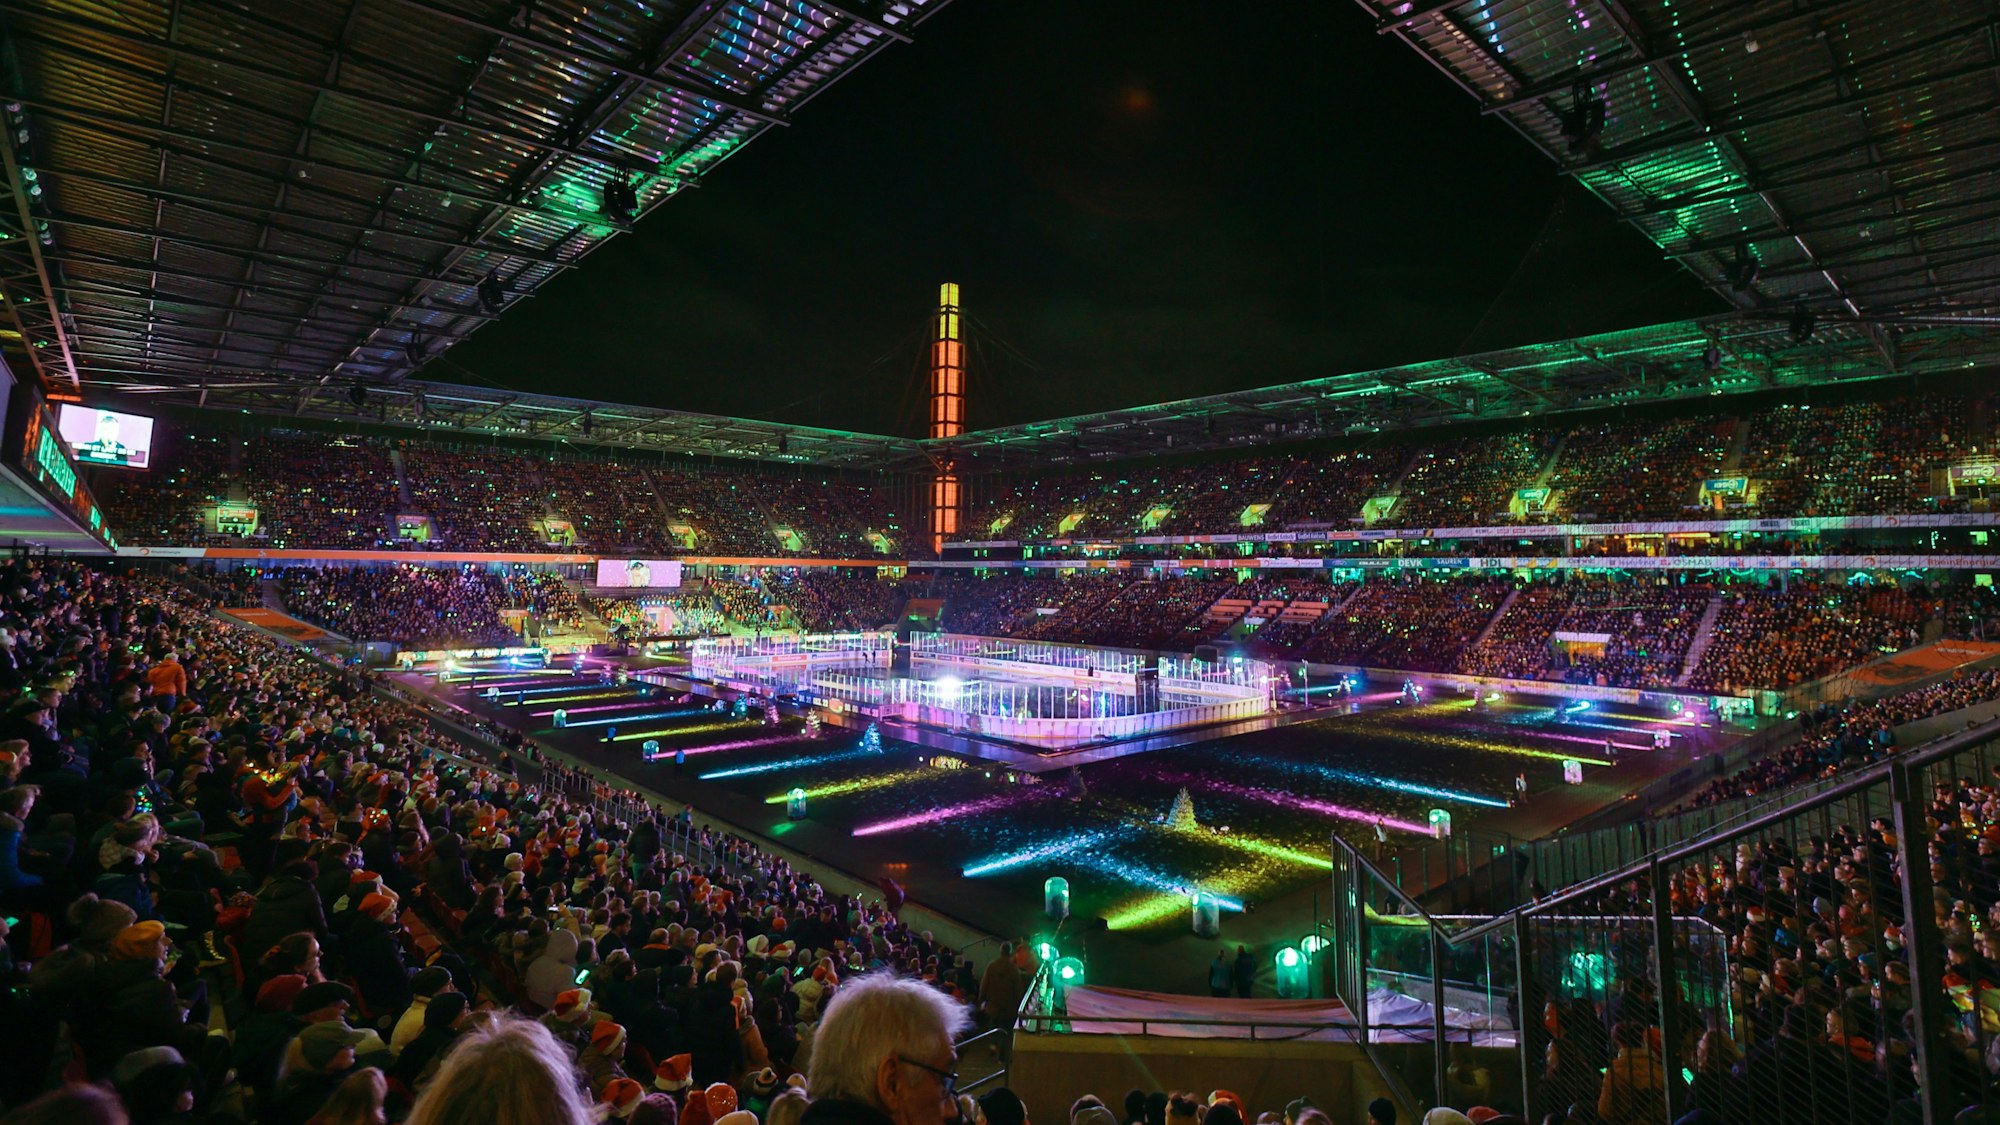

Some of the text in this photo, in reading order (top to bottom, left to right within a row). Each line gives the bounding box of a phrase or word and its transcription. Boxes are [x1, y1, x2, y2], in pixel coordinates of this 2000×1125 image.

[1398, 558, 1423, 567] DEVK
[1480, 558, 1502, 567] HDI
[1673, 558, 1713, 567] OSMAB
